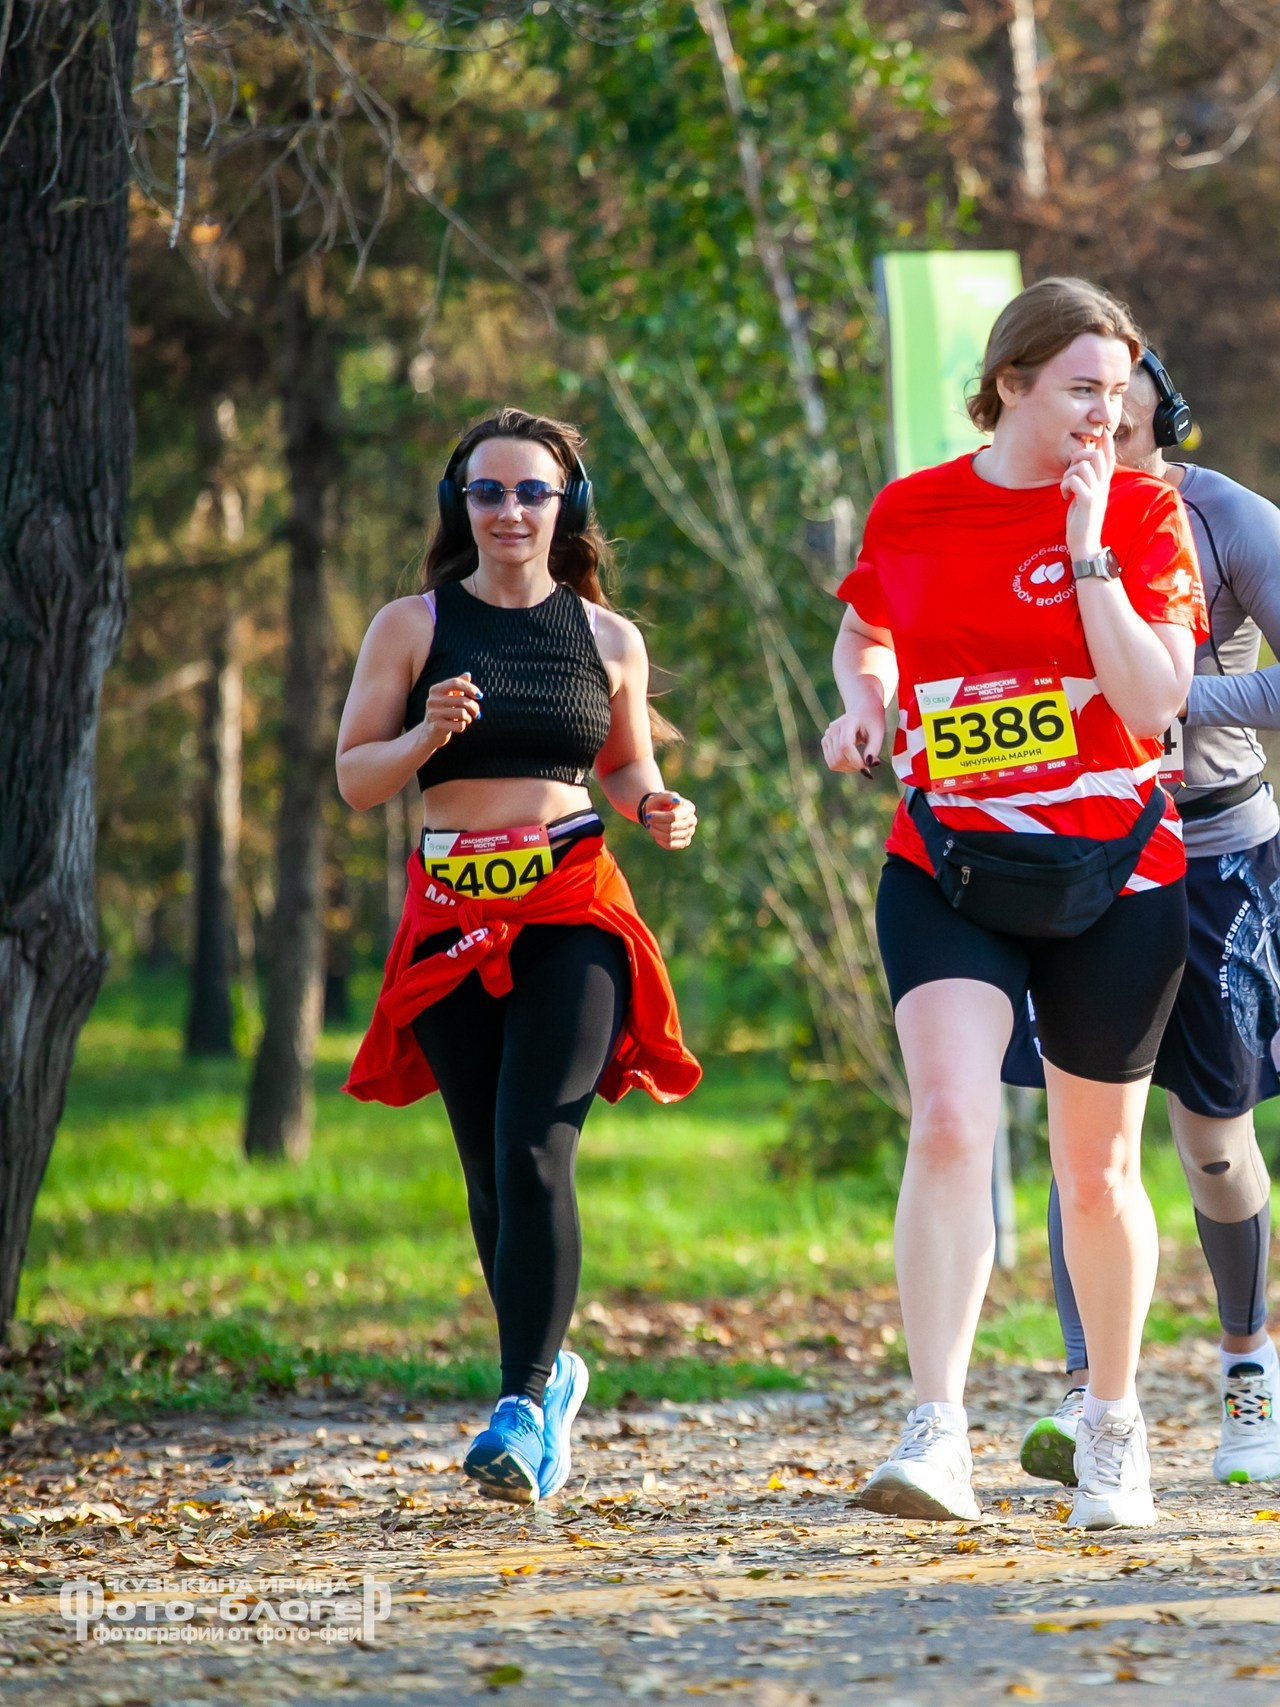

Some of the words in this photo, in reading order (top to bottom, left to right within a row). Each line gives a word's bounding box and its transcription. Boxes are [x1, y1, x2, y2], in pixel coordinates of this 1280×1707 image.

[1012, 574, 1033, 604] крови
[964, 678, 1018, 693] КРАСНОЯРСКИЕ
[978, 687, 1004, 696] МОСТЫ
[932, 699, 1065, 761] 5386
[960, 754, 1007, 768] ЧИЧУРИНА
[1008, 748, 1042, 761] МАРИЯ
[1047, 760, 1066, 770] 2026
[430, 854, 553, 897] 5404
[1218, 965, 1230, 999] БУДЬ
